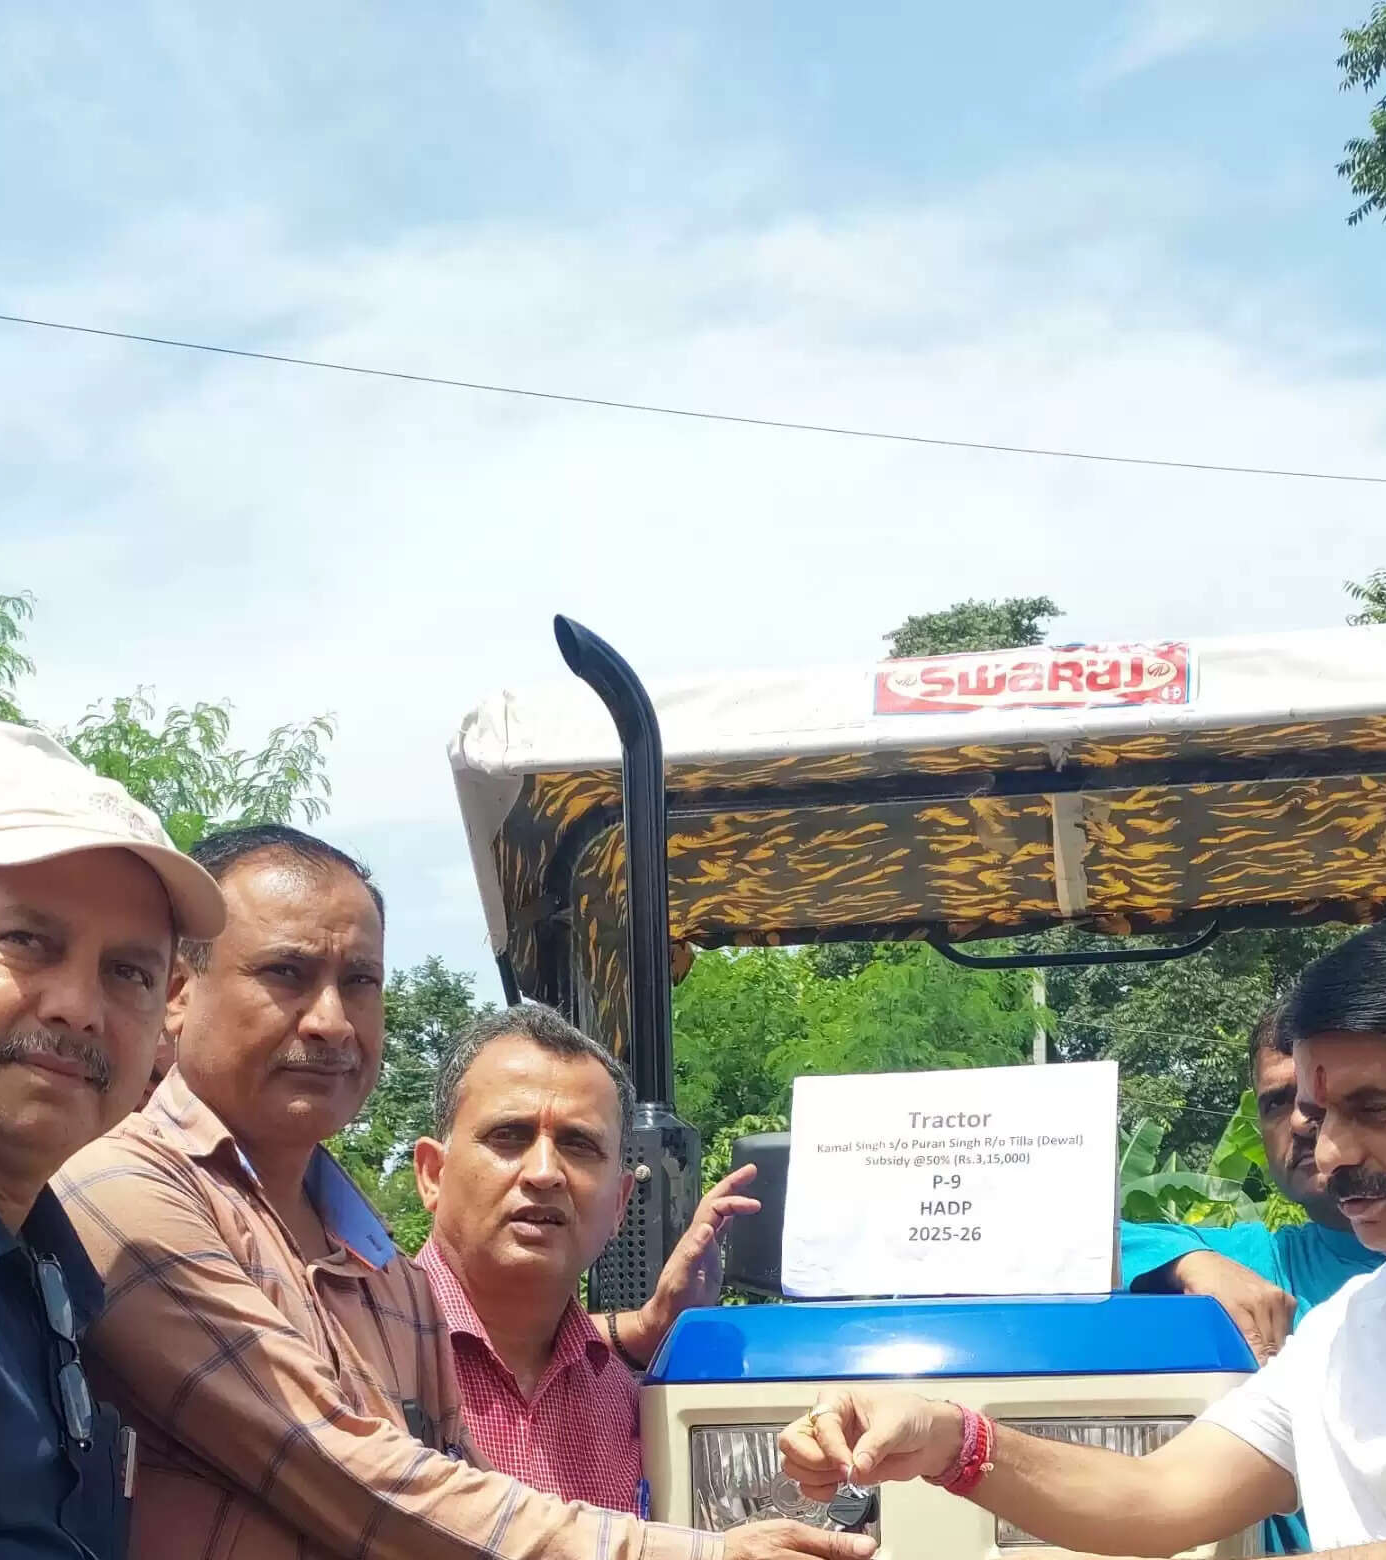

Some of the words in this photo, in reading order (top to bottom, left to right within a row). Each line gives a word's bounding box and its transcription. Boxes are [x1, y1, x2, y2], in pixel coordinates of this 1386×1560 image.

[908, 1111, 992, 1129] Tractor
[817, 1141, 853, 1153] Kamal
[855, 1140, 885, 1152] Singh
[889, 1137, 909, 1151] s/o
[912, 1139, 946, 1149] Puran
[949, 1137, 981, 1150] Singh
[984, 1136, 1006, 1149] R/o
[1009, 1135, 1033, 1146] Tilla
[1037, 1134, 1084, 1148] (Dewal)
[865, 1155, 910, 1168] Subsidy
[913, 1155, 951, 1167] @50%
[954, 1152, 1031, 1167] (Rs.3,15,000)
[932, 1174, 961, 1189] P-9
[919, 1200, 973, 1216] HADP
[908, 1227, 982, 1242] 2025-26
